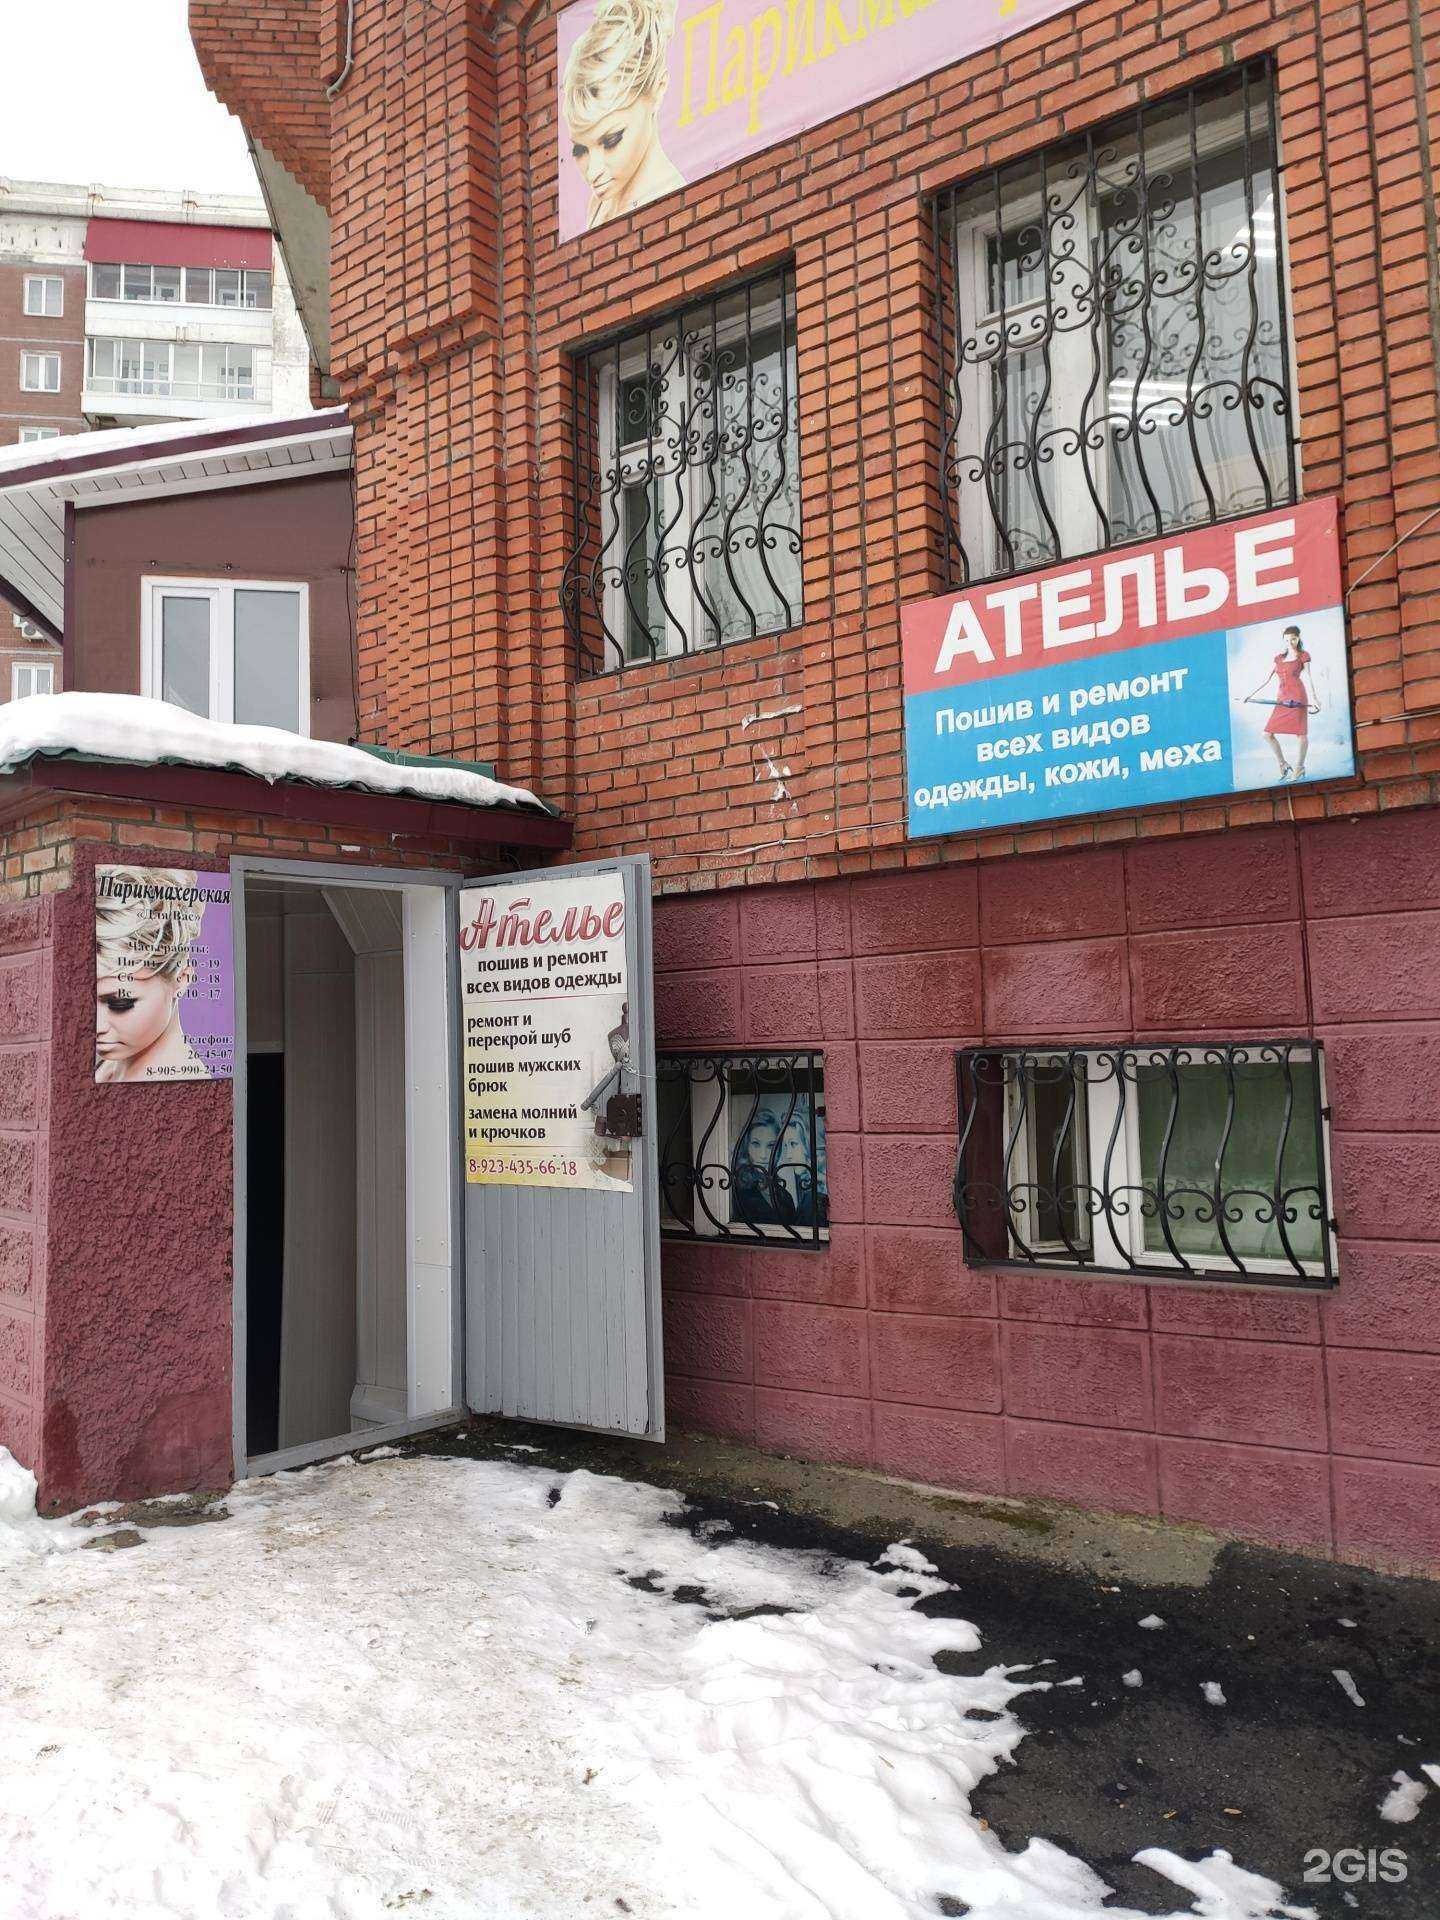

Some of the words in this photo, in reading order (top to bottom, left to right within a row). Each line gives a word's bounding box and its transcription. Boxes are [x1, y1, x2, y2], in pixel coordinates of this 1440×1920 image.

[933, 518, 1300, 674] АТЕЛЬЕ
[935, 699, 1034, 736] Пошив
[1042, 694, 1060, 714] и
[1069, 666, 1189, 709] ремонт
[976, 731, 1044, 763] всех
[1052, 713, 1151, 752] видов
[913, 770, 1035, 809] одежды,
[1044, 756, 1129, 786] кожи,
[1139, 738, 1223, 772] меха
[98, 875, 231, 907] Парикмахерская
[460, 897, 624, 951] Ателье
[187, 959, 198, 967] 10
[208, 959, 220, 967] 19
[478, 957, 528, 972] пошив
[534, 956, 542, 967] и
[547, 951, 607, 971] ремонт
[117, 973, 134, 982] Сб
[187, 975, 198, 983] 10
[208, 975, 220, 983] 18
[467, 981, 499, 994] всех
[504, 976, 550, 992] видов
[555, 971, 621, 988] одежды
[118, 989, 131, 997] Вс
[187, 990, 198, 998] 10
[208, 990, 220, 998] 17
[468, 1016, 519, 1032] ремонт
[524, 1015, 531, 1025] и
[183, 1034, 232, 1045] Телефон:
[468, 1031, 537, 1049] перекрой
[541, 1028, 571, 1047] шуб
[187, 1049, 232, 1059] 26-45-07
[146, 1065, 232, 1076] 8-905-990-24-50
[468, 1061, 514, 1074] пошив
[518, 1057, 581, 1075] мужских
[469, 1077, 507, 1094] брюк
[468, 1106, 517, 1120] замена
[522, 1103, 577, 1119] молний
[468, 1128, 477, 1138] и
[481, 1127, 546, 1142] крючков
[469, 1159, 577, 1176] 8-923-435-66-18
